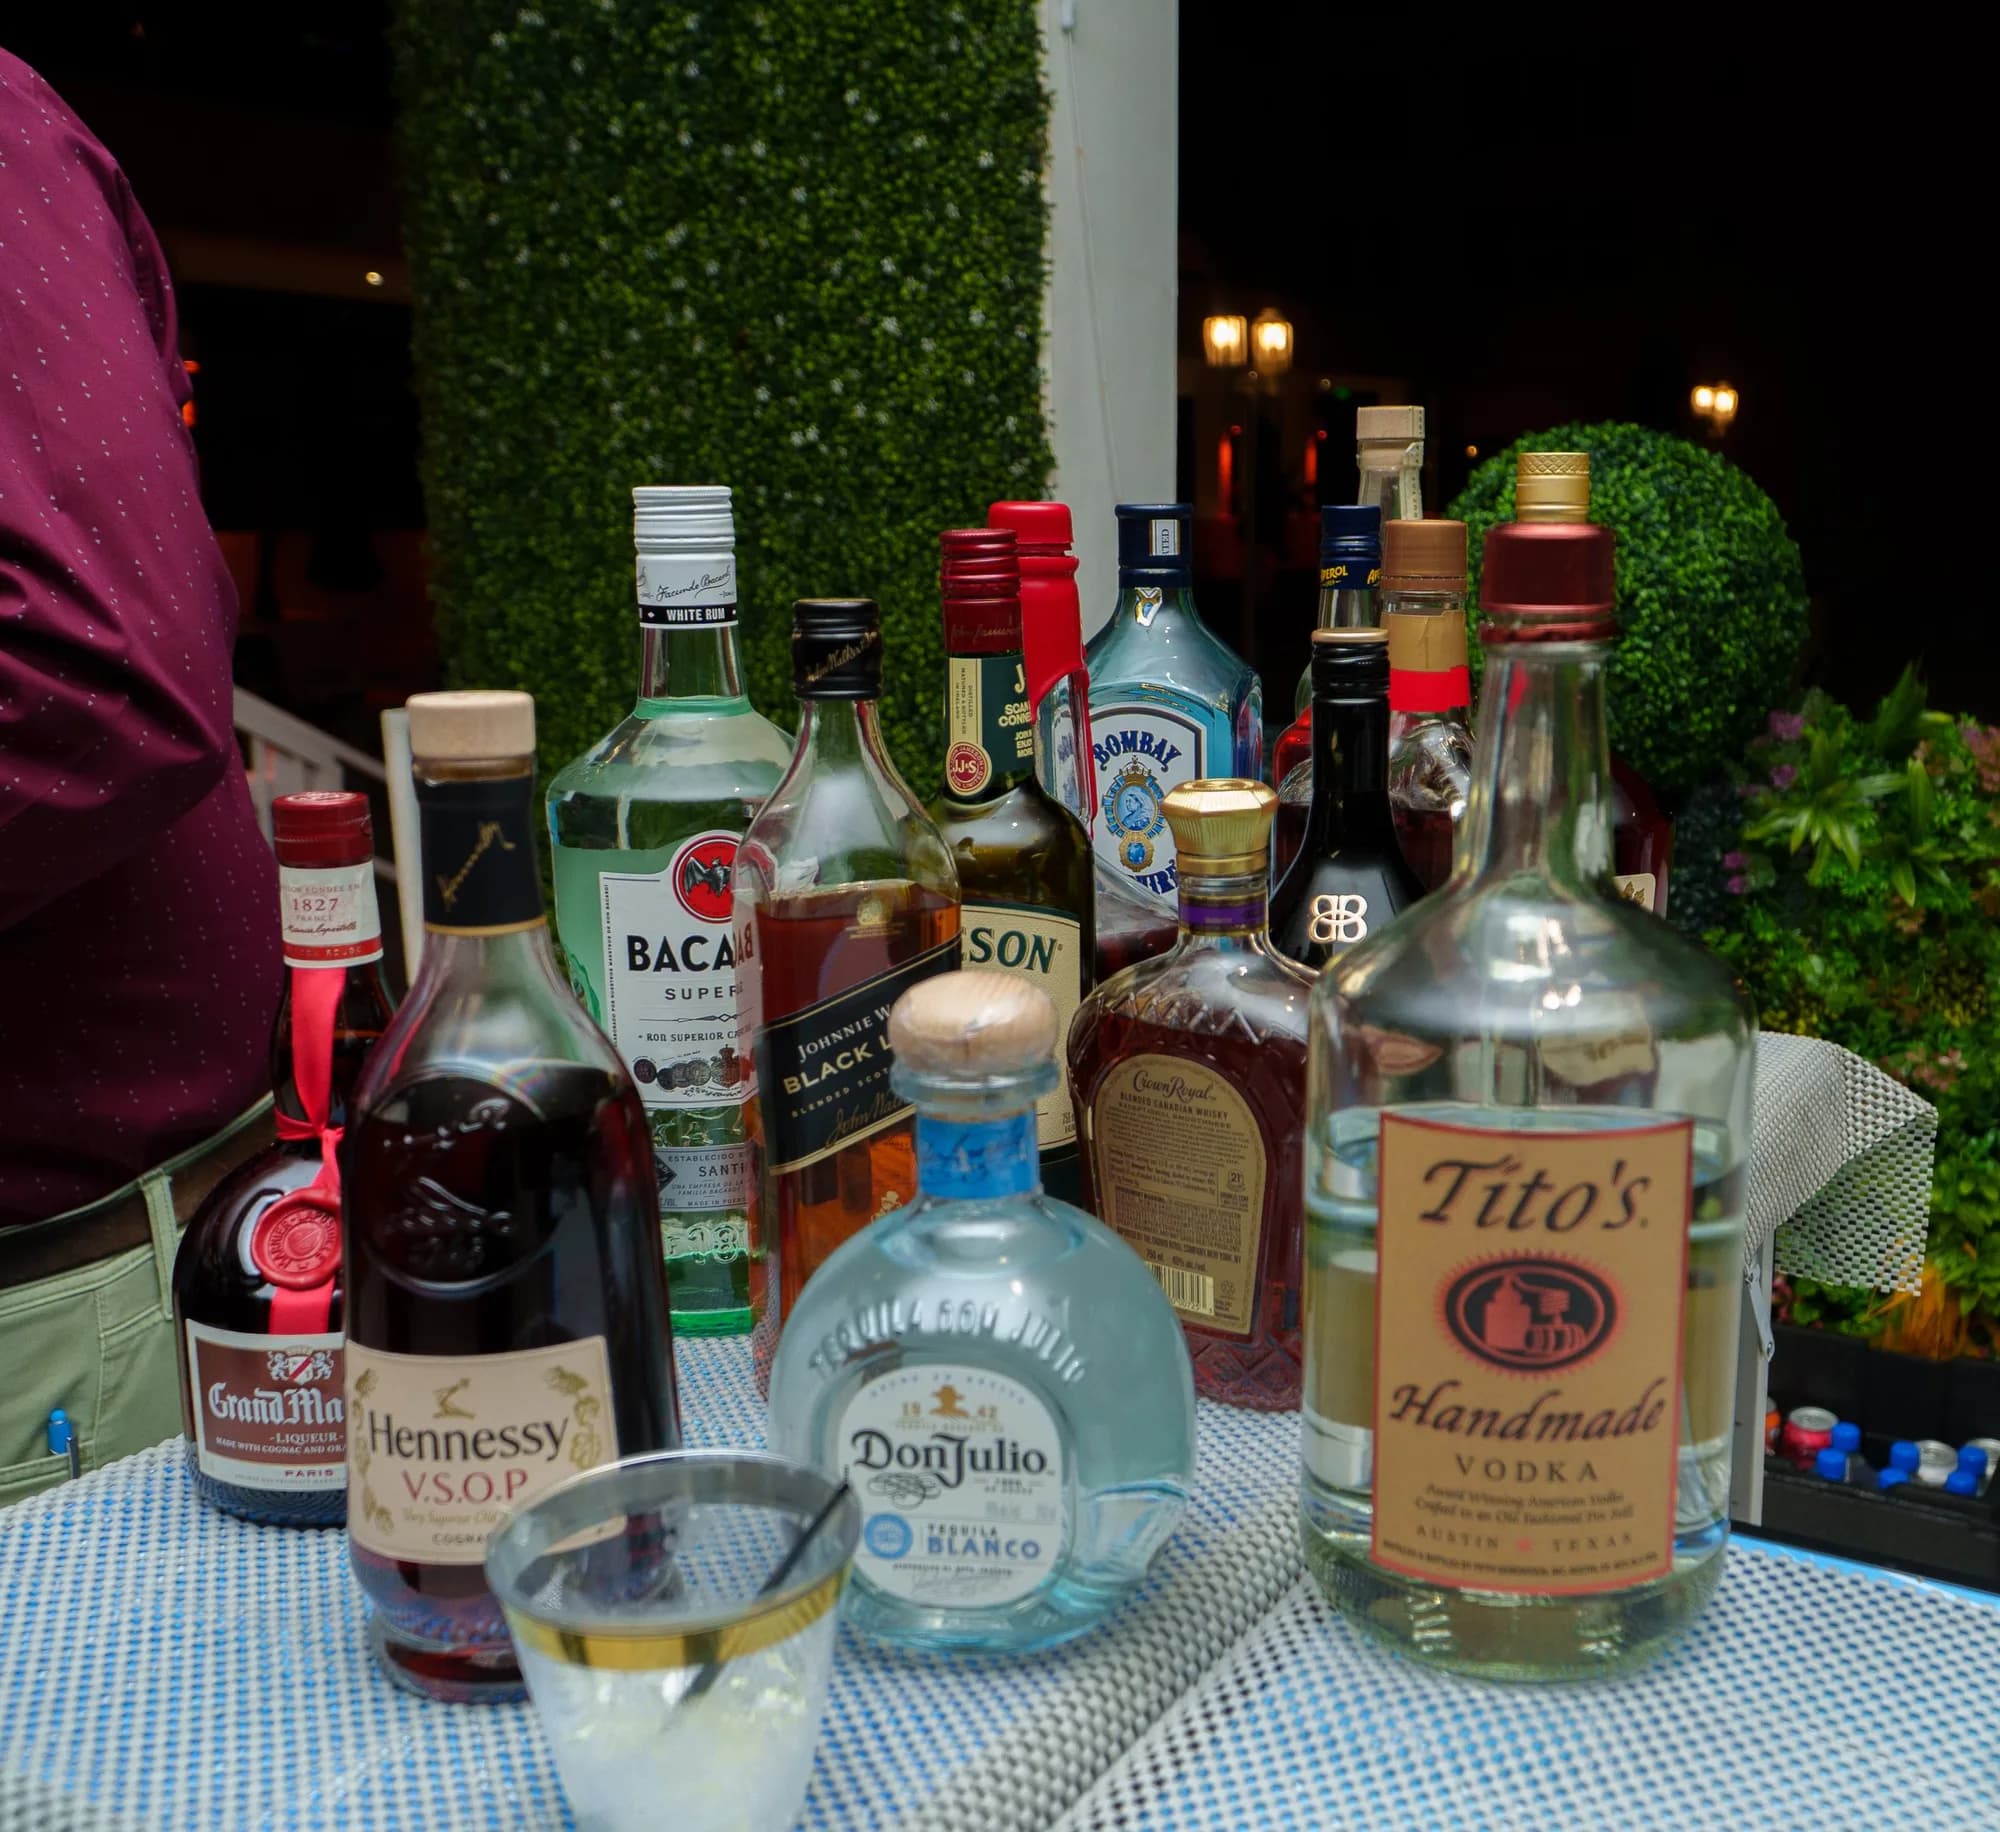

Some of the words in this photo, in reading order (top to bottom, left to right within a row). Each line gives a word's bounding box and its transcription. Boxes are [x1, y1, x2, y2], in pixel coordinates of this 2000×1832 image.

[666, 608, 704, 622] WHITE
[705, 607, 726, 620] RUM
[1093, 730, 1183, 773] BOMBAY
[292, 897, 339, 912] 1827
[671, 1031, 725, 1042] SUPERIOR
[797, 1015, 874, 1064] JOHNNIE
[783, 1040, 874, 1095] BLACK
[791, 1086, 851, 1118] BLENDED
[1153, 1098, 1194, 1114] CANADIAN
[1196, 1107, 1230, 1120] WHISKY
[667, 1152, 735, 1163] ESTABLECIDO
[1418, 1154, 1652, 1233] Tito's
[208, 1381, 285, 1425] Grand
[282, 1387, 345, 1425] Ma
[1388, 1377, 1668, 1443] Handmade
[215, 1436, 237, 1448] MADE
[237, 1441, 261, 1452] WITH
[262, 1445, 301, 1454] COGNAC
[303, 1445, 325, 1454] AND
[368, 1409, 569, 1463] Hennessy
[284, 1469, 335, 1478] PARIS
[1455, 1453, 1599, 1483] VODKA
[401, 1467, 529, 1506] V.S.O.P
[927, 1523, 998, 1536] TEQUILA
[1552, 1533, 1633, 1552] TEXAS
[927, 1536, 1041, 1560] BLANCO
